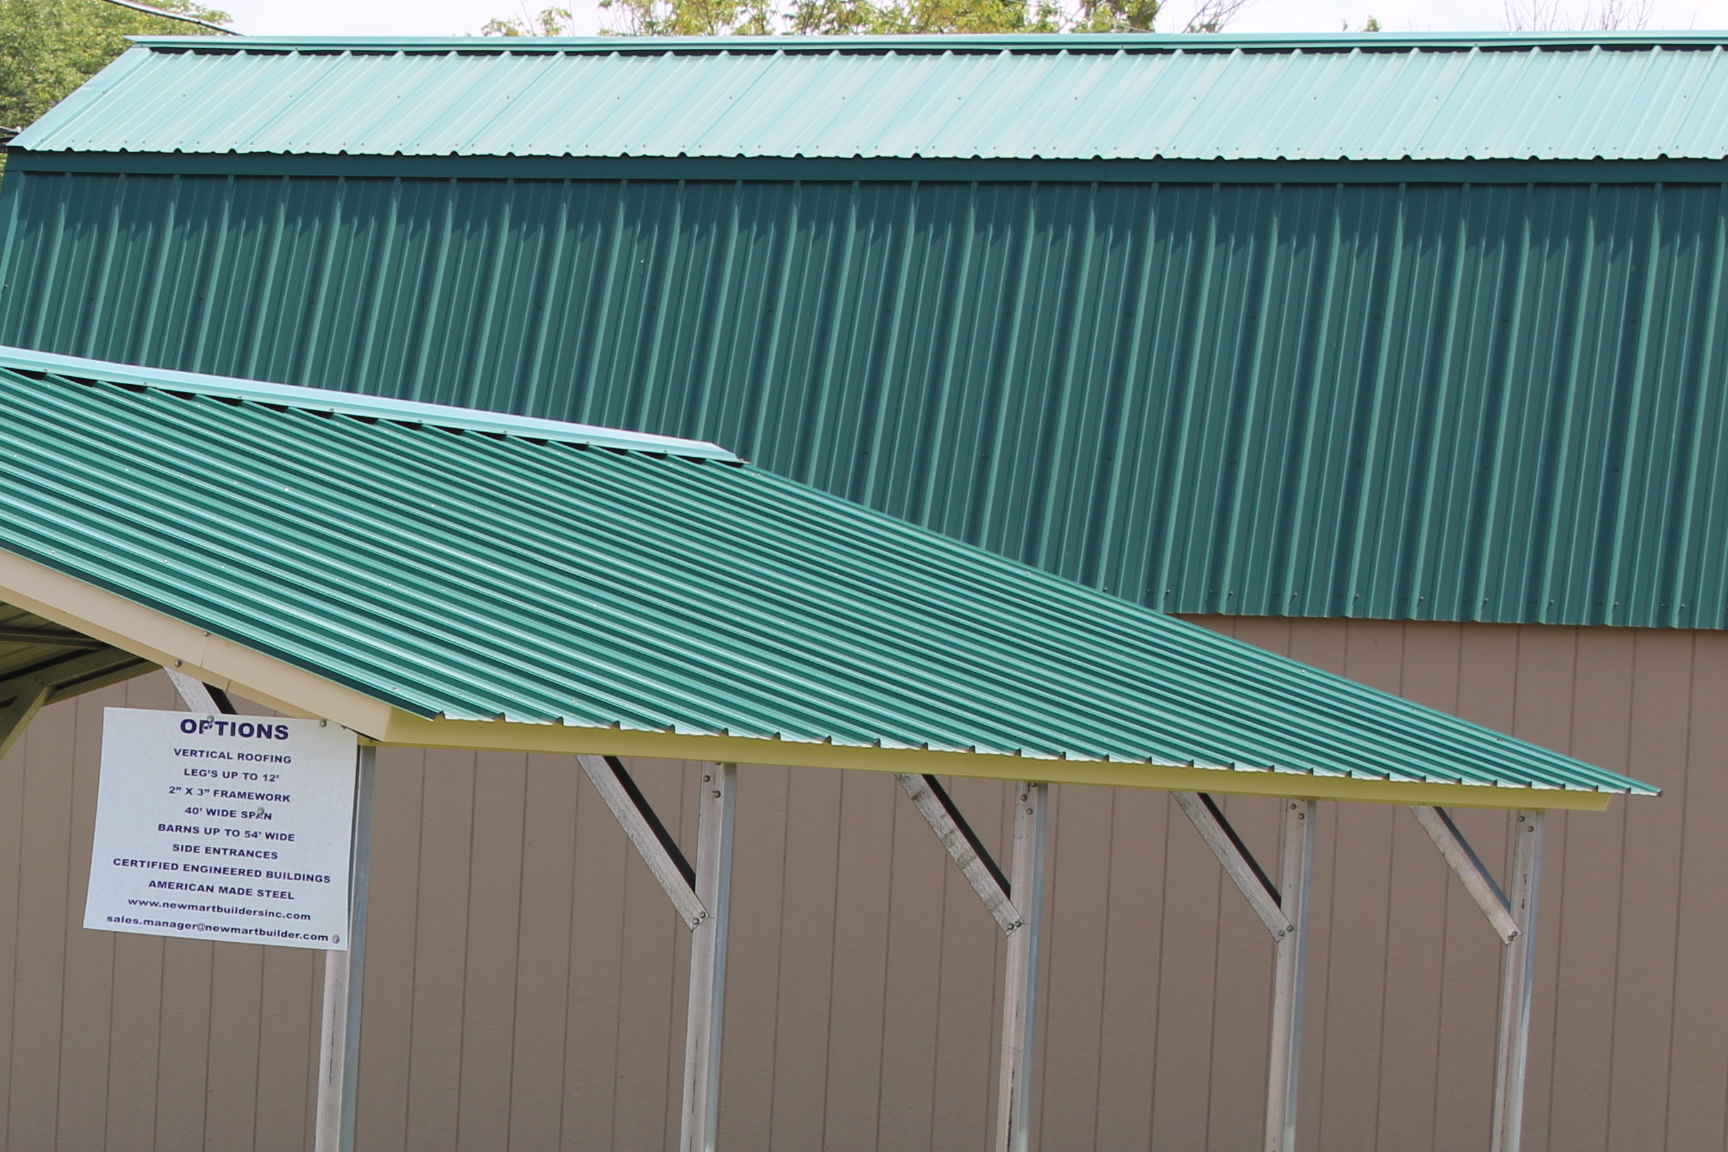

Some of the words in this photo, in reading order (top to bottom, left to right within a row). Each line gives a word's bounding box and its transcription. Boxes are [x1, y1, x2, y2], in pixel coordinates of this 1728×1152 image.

[180, 718, 288, 740] OPTIONS
[174, 748, 233, 760] VERTICAL
[237, 753, 291, 763] ROOFING
[184, 768, 218, 778] LEG'S
[221, 770, 239, 780] UP
[241, 772, 259, 781] TO
[184, 787, 194, 796] X
[214, 790, 290, 802] FRAMEWORK
[206, 808, 236, 817] WIDE
[158, 824, 199, 834] BARNS
[203, 826, 221, 836] UP
[224, 828, 241, 838] TO
[265, 832, 294, 841] WIDE
[173, 844, 200, 853] SIDE
[205, 847, 277, 859] ENTRANCES
[113, 858, 178, 870] CERTIFIED
[183, 864, 262, 877] ENGINEERED
[266, 871, 330, 883] BUILDINGS
[148, 880, 214, 893] AMERICAN
[219, 886, 252, 896] MADE
[257, 889, 294, 899] STEEL
[127, 898, 310, 921] www.newmartbuildersinc.com
[106, 914, 328, 942] sales.manager@newmartbuilder.com
